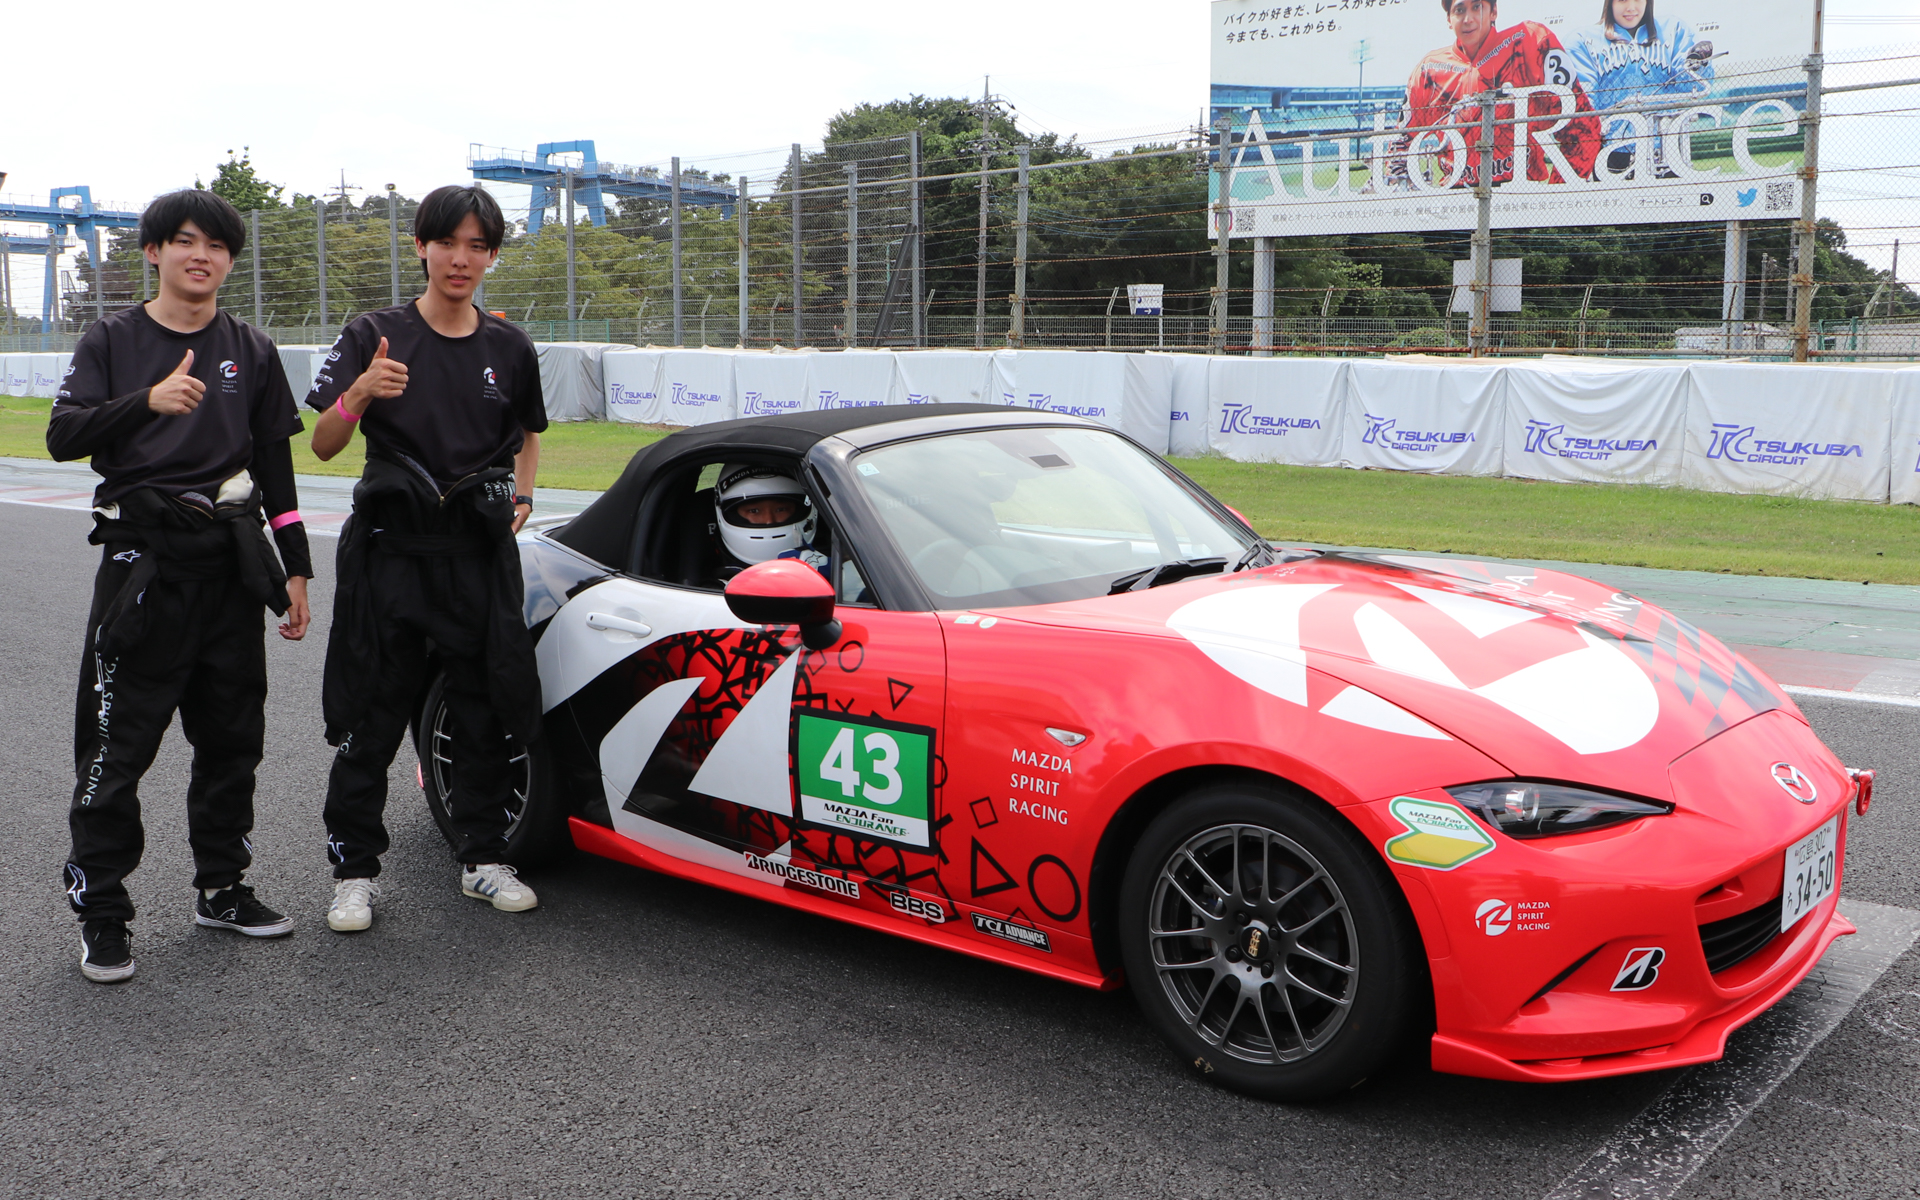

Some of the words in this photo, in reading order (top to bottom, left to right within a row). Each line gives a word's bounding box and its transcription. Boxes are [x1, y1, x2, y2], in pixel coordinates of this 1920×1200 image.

[1226, 19, 1342, 44] 今までも、これからも。
[624, 391, 657, 399] TSUKUBA
[687, 392, 721, 402] TSUKUBA
[762, 400, 801, 409] TSUKUBA
[1252, 416, 1321, 430] TSUKUBA
[1395, 430, 1475, 443] TSUKUBA
[1563, 437, 1657, 451] TSUKUBA
[1754, 440, 1863, 458] TSUKUBA
[820, 727, 903, 805] 43
[1011, 748, 1072, 774] MAZDA
[1010, 773, 1060, 797] SPIRIT
[824, 803, 868, 819] MAZDA
[871, 813, 893, 825] Fan
[1009, 797, 1068, 825] RACING
[1409, 811, 1442, 821] MAZDA
[1445, 816, 1461, 824] Fan
[836, 814, 908, 836] ENDURANCE
[744, 851, 860, 899] BRIDGESTONE
[1794, 850, 1834, 916] 34-50
[890, 891, 945, 924] BBS
[1517, 901, 1550, 909] MAZDA
[1517, 912, 1544, 920] SPIRIT
[975, 916, 1004, 933] TCL
[1005, 924, 1047, 946] ADVANCE
[1517, 922, 1550, 931] RACING
